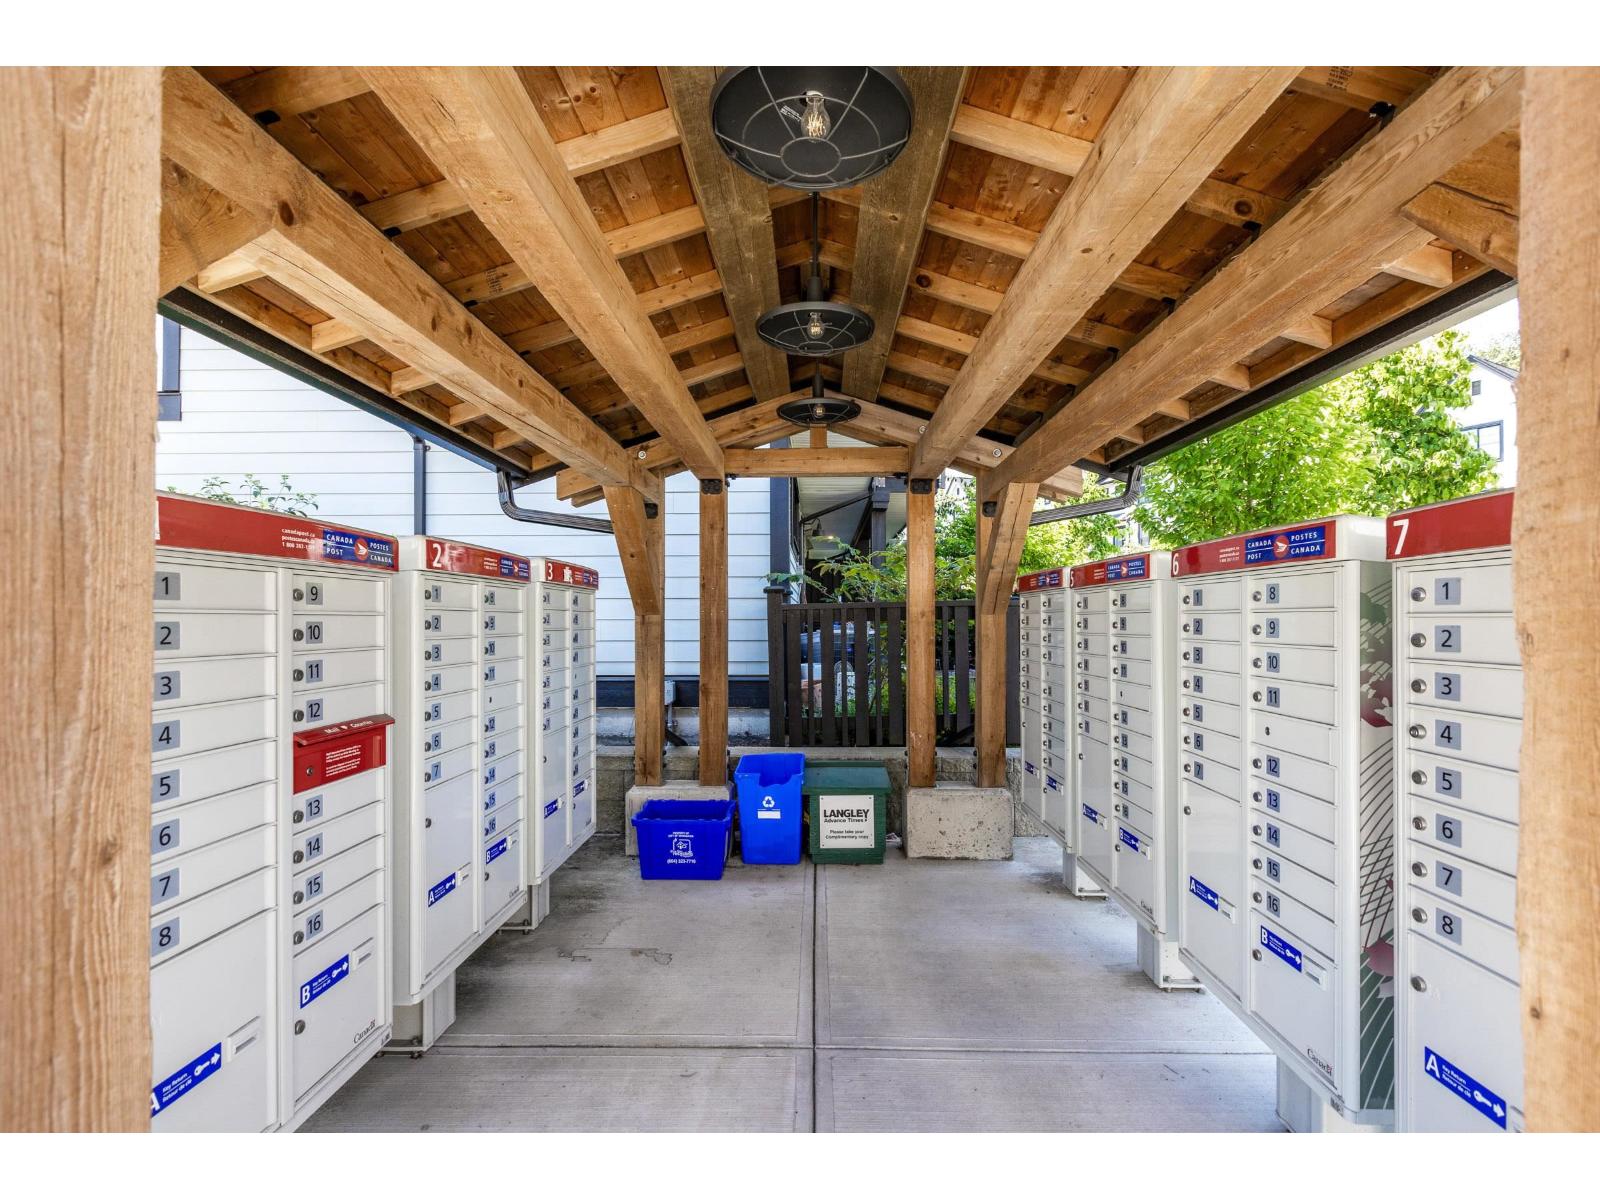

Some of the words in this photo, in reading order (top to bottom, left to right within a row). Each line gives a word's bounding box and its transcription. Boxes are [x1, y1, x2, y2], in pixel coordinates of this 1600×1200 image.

[326, 534, 353, 544] CANADA
[1248, 540, 1272, 548] CANADA
[1291, 532, 1317, 541] POSTES
[1393, 518, 1409, 555] 7
[326, 547, 343, 555] POST
[370, 543, 389, 551] POSTES
[1291, 545, 1320, 554] CANADA
[370, 555, 392, 563] CANADA
[432, 543, 442, 568] 2
[548, 563, 553, 580] 3
[1172, 553, 1179, 575] 6
[160, 576, 170, 595] 1
[1071, 571, 1074, 587] 5
[310, 586, 319, 602] 9
[434, 588, 439, 599] 1
[1195, 592, 1200, 603] 1
[1269, 586, 1276, 600] 8
[1441, 582, 1449, 601] 1
[307, 624, 321, 640] 10
[434, 618, 439, 630] 2
[1195, 621, 1200, 632] 2
[1269, 620, 1275, 635] 9
[159, 626, 172, 645] 2
[1440, 629, 1453, 648] 2
[434, 648, 440, 659] 3
[1195, 649, 1200, 662] 3
[1268, 655, 1278, 669] 10
[308, 663, 320, 679] 11
[160, 675, 172, 696] 3
[433, 676, 439, 687] 4
[1195, 678, 1200, 690] 4
[1441, 677, 1453, 695] 3
[1268, 689, 1278, 704] 11
[308, 702, 321, 719] 12
[434, 706, 439, 718] 5
[1195, 706, 1200, 719] 5
[158, 725, 173, 746] 4
[433, 735, 440, 748] 6
[1196, 735, 1200, 748] 6
[1440, 725, 1453, 743] 4
[433, 764, 440, 777] 7
[1196, 764, 1201, 777] 7
[1268, 758, 1277, 773] 12
[159, 775, 172, 797] 5
[1441, 772, 1453, 791] 5
[307, 799, 321, 816] 13
[1268, 793, 1278, 808] 13
[824, 809, 869, 818] LANGLEY
[159, 826, 172, 846] 6
[1267, 827, 1278, 843] 14
[1441, 820, 1454, 839] 6
[307, 837, 321, 856] 14
[487, 850, 490, 863] B
[1268, 861, 1278, 878] 15
[1441, 866, 1454, 886] 7
[159, 876, 172, 897] 7
[307, 876, 321, 895] 15
[1191, 879, 1196, 892] A
[429, 891, 435, 905] A
[1268, 896, 1278, 913] 16
[307, 914, 321, 933] 16
[1441, 915, 1454, 935] 8
[158, 926, 172, 947] 8
[1262, 928, 1268, 944] B
[303, 985, 310, 1004] B
[1426, 1054, 1440, 1079] A
